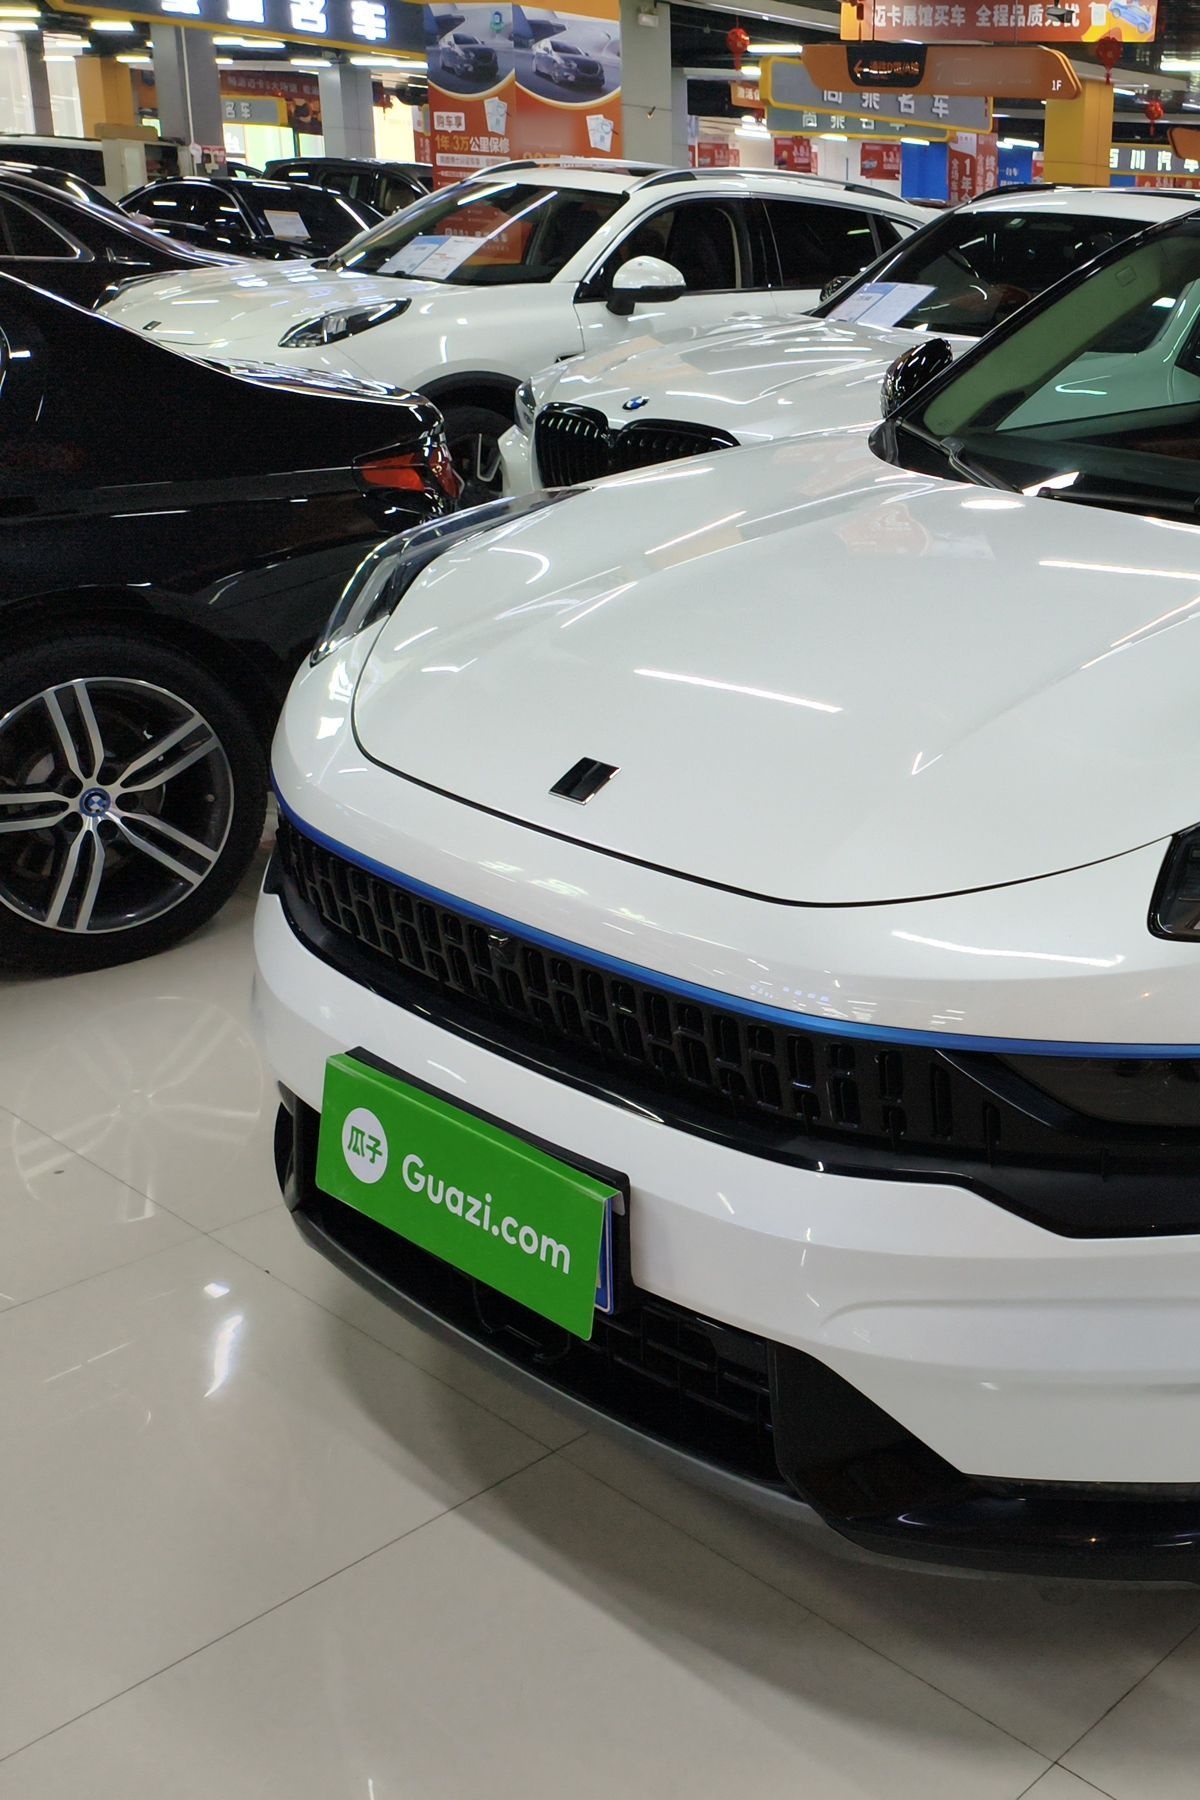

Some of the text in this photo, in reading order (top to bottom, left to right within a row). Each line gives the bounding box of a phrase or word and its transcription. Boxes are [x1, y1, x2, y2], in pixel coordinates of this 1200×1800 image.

[161, 0, 388, 41] 名车
[1051, 79, 1062, 91] 1F
[453, 134, 510, 153] 3万公里保修
[347, 1125, 383, 1163] 瓜子
[402, 1153, 571, 1274] Guazi.com
